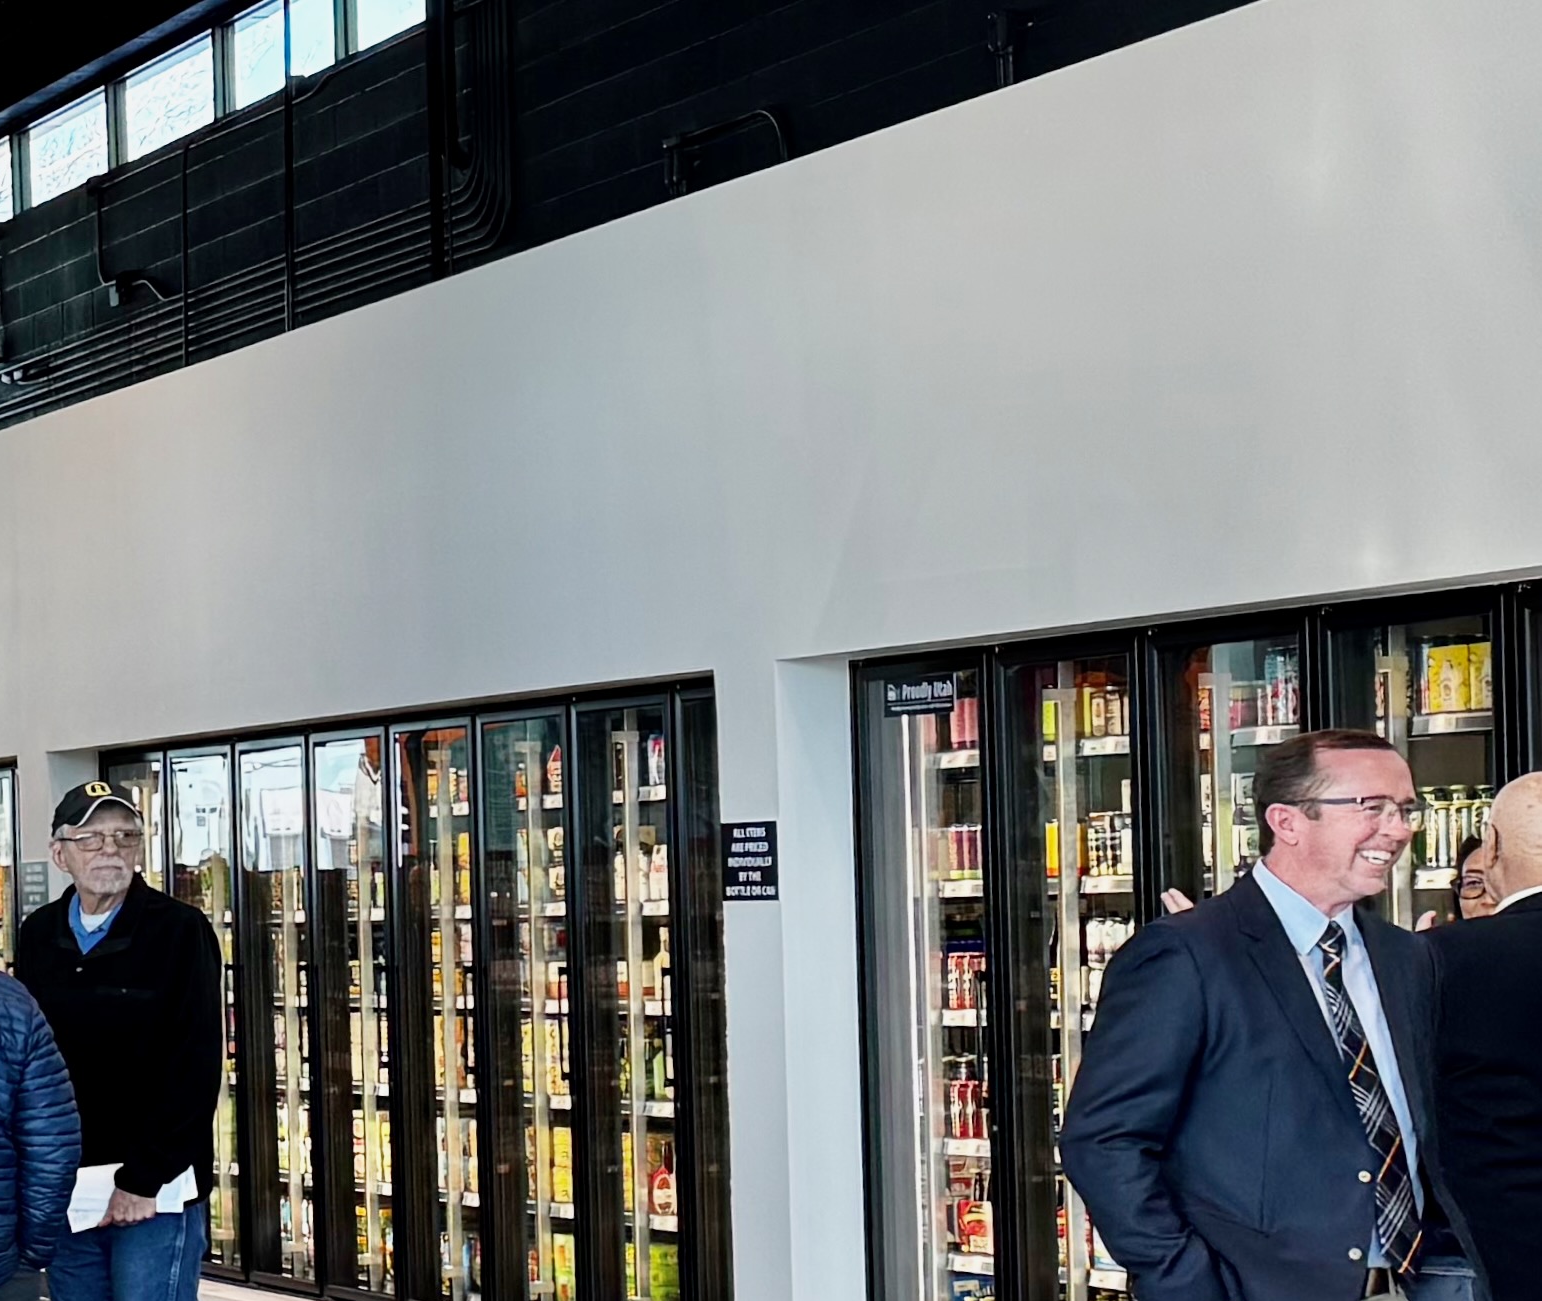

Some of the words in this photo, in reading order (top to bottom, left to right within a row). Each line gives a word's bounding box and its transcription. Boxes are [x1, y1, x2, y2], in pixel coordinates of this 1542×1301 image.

[902, 682, 932, 702] Proudly
[933, 680, 953, 697] Utah
[732, 828, 745, 838] ALL
